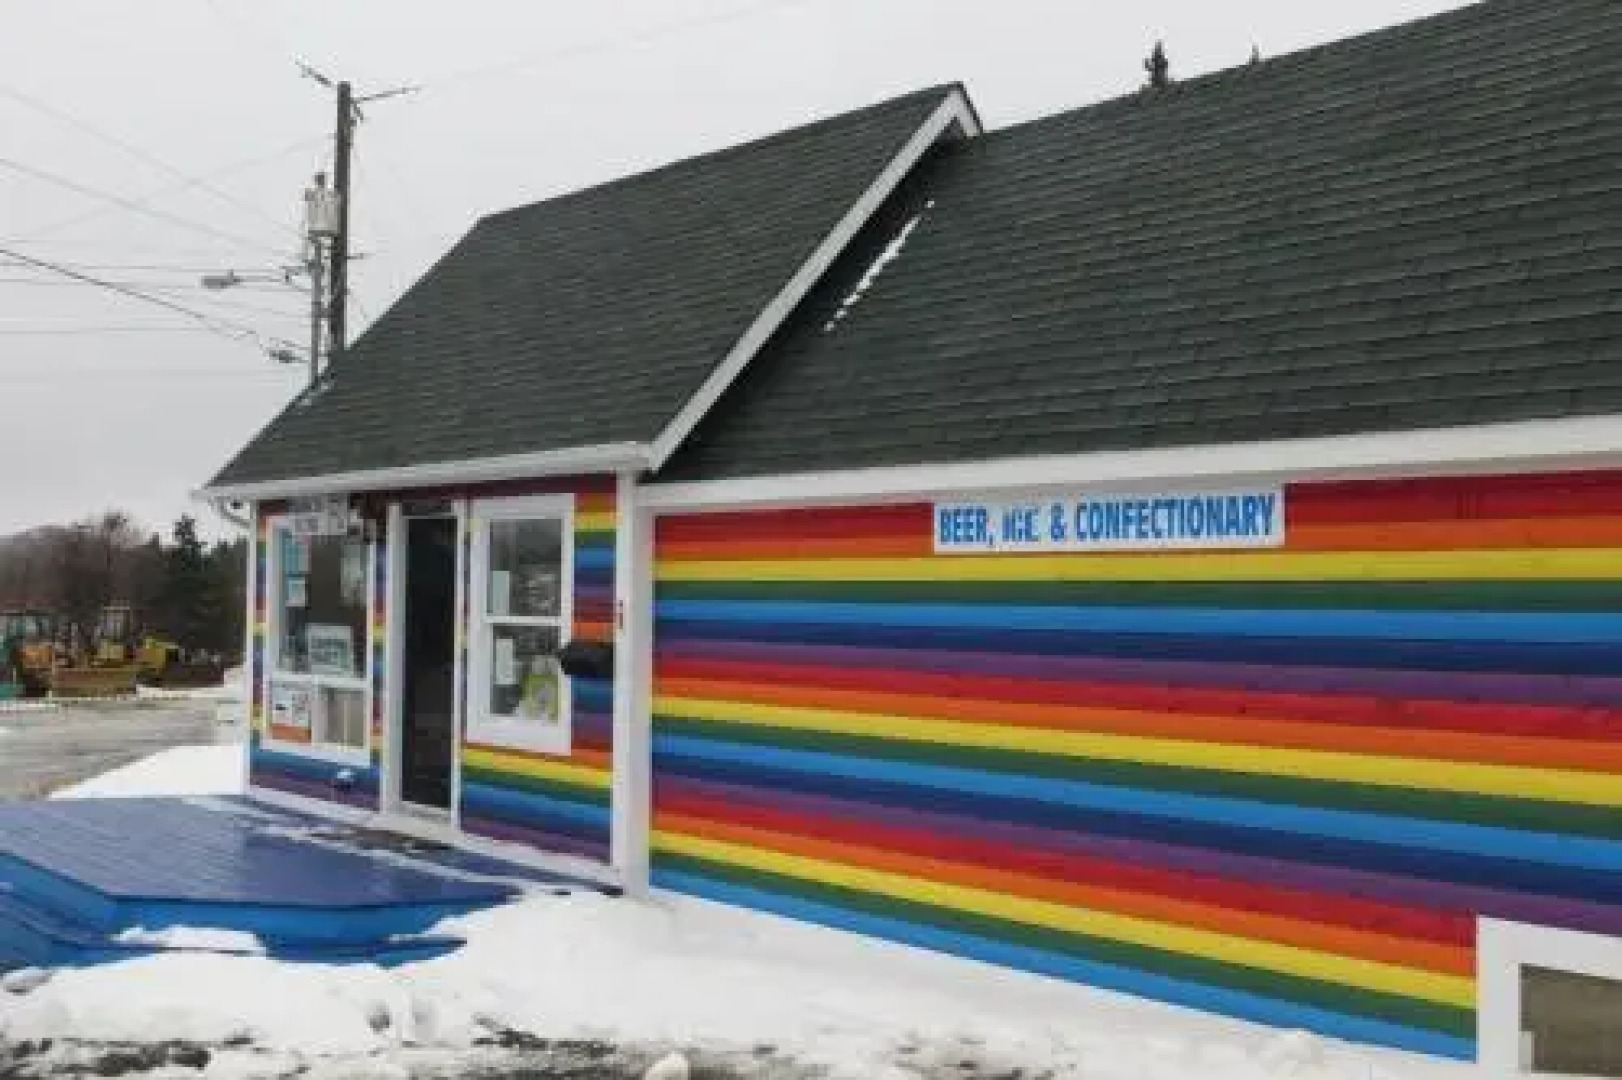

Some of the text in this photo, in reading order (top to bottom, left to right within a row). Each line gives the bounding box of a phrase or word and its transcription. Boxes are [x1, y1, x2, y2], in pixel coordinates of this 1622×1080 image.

[940, 507, 993, 546] BEER,
[1050, 502, 1068, 542] &
[1076, 493, 1276, 540] CONFECTIONARY
